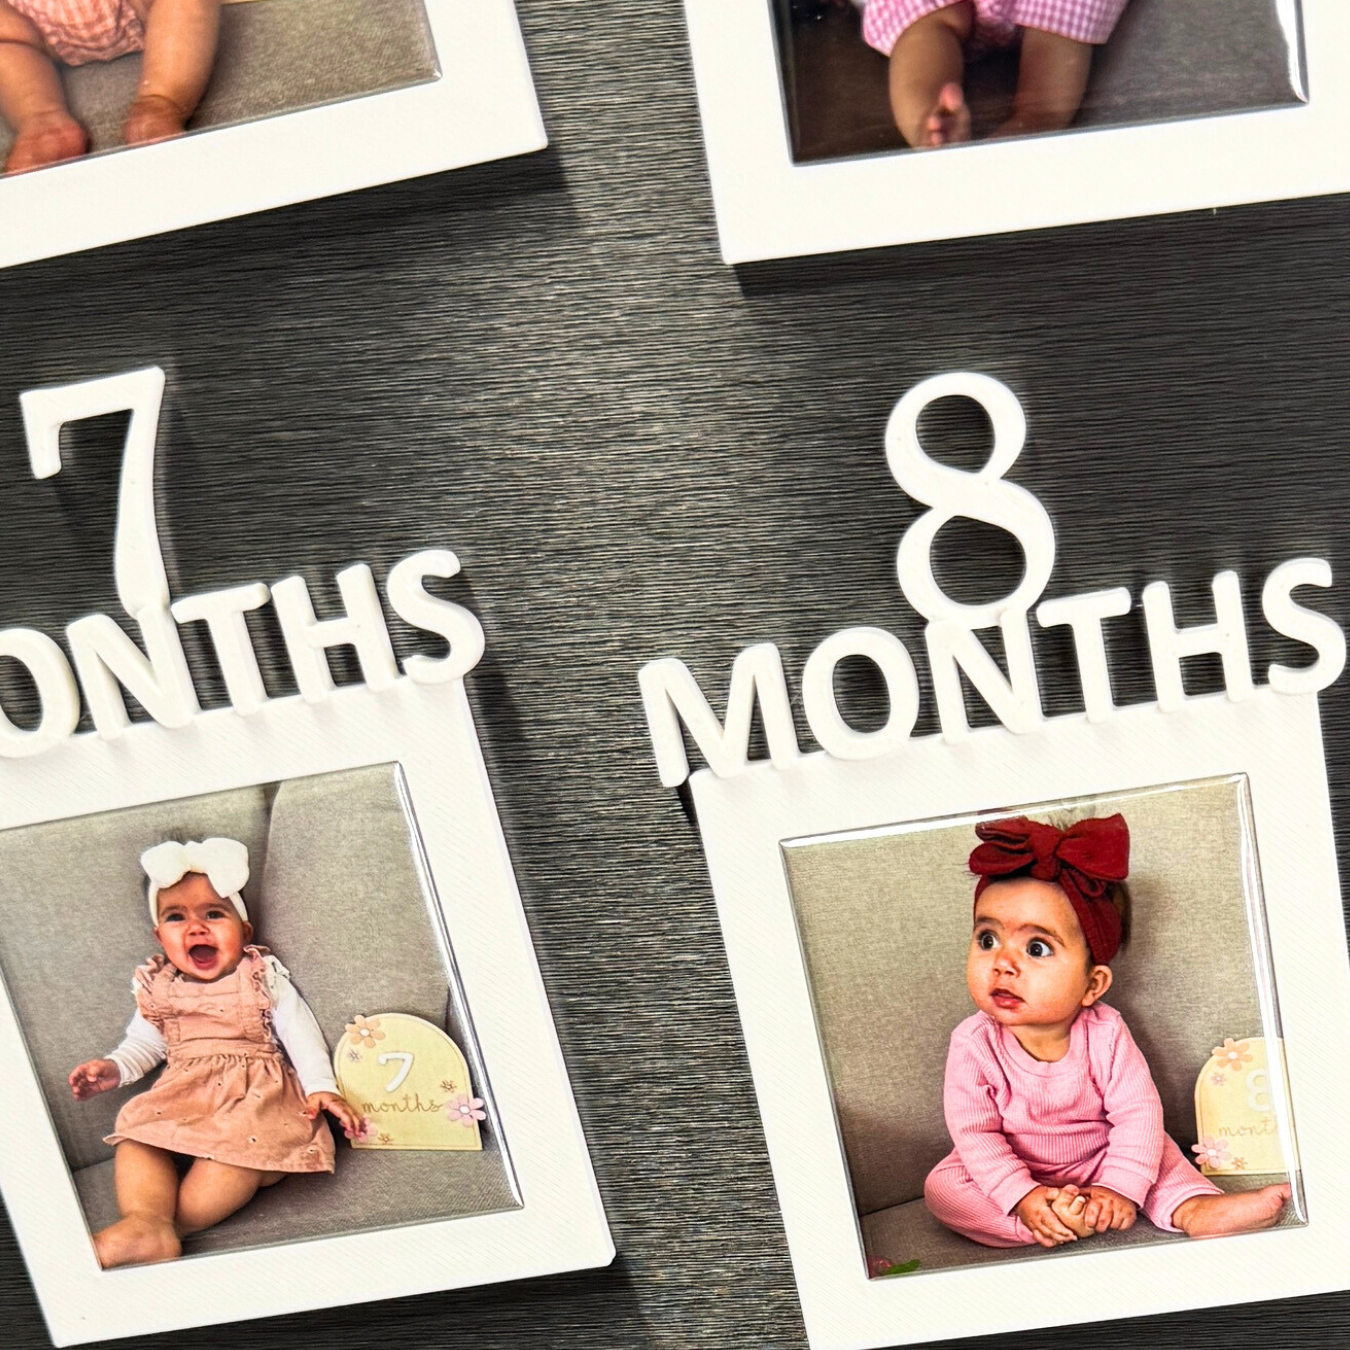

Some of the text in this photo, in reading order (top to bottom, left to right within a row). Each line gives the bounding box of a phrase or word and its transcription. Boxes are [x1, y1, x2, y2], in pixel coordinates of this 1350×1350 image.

[20, 366, 170, 620] 7
[885, 371, 1055, 628] 8
[0, 549, 486, 758] ONTHS
[637, 557, 1347, 788] MONTHS
[362, 1093, 443, 1113] months
[378, 1050, 415, 1092] 7
[1218, 1116, 1278, 1138] mont
[1245, 1068, 1274, 1112] 8
